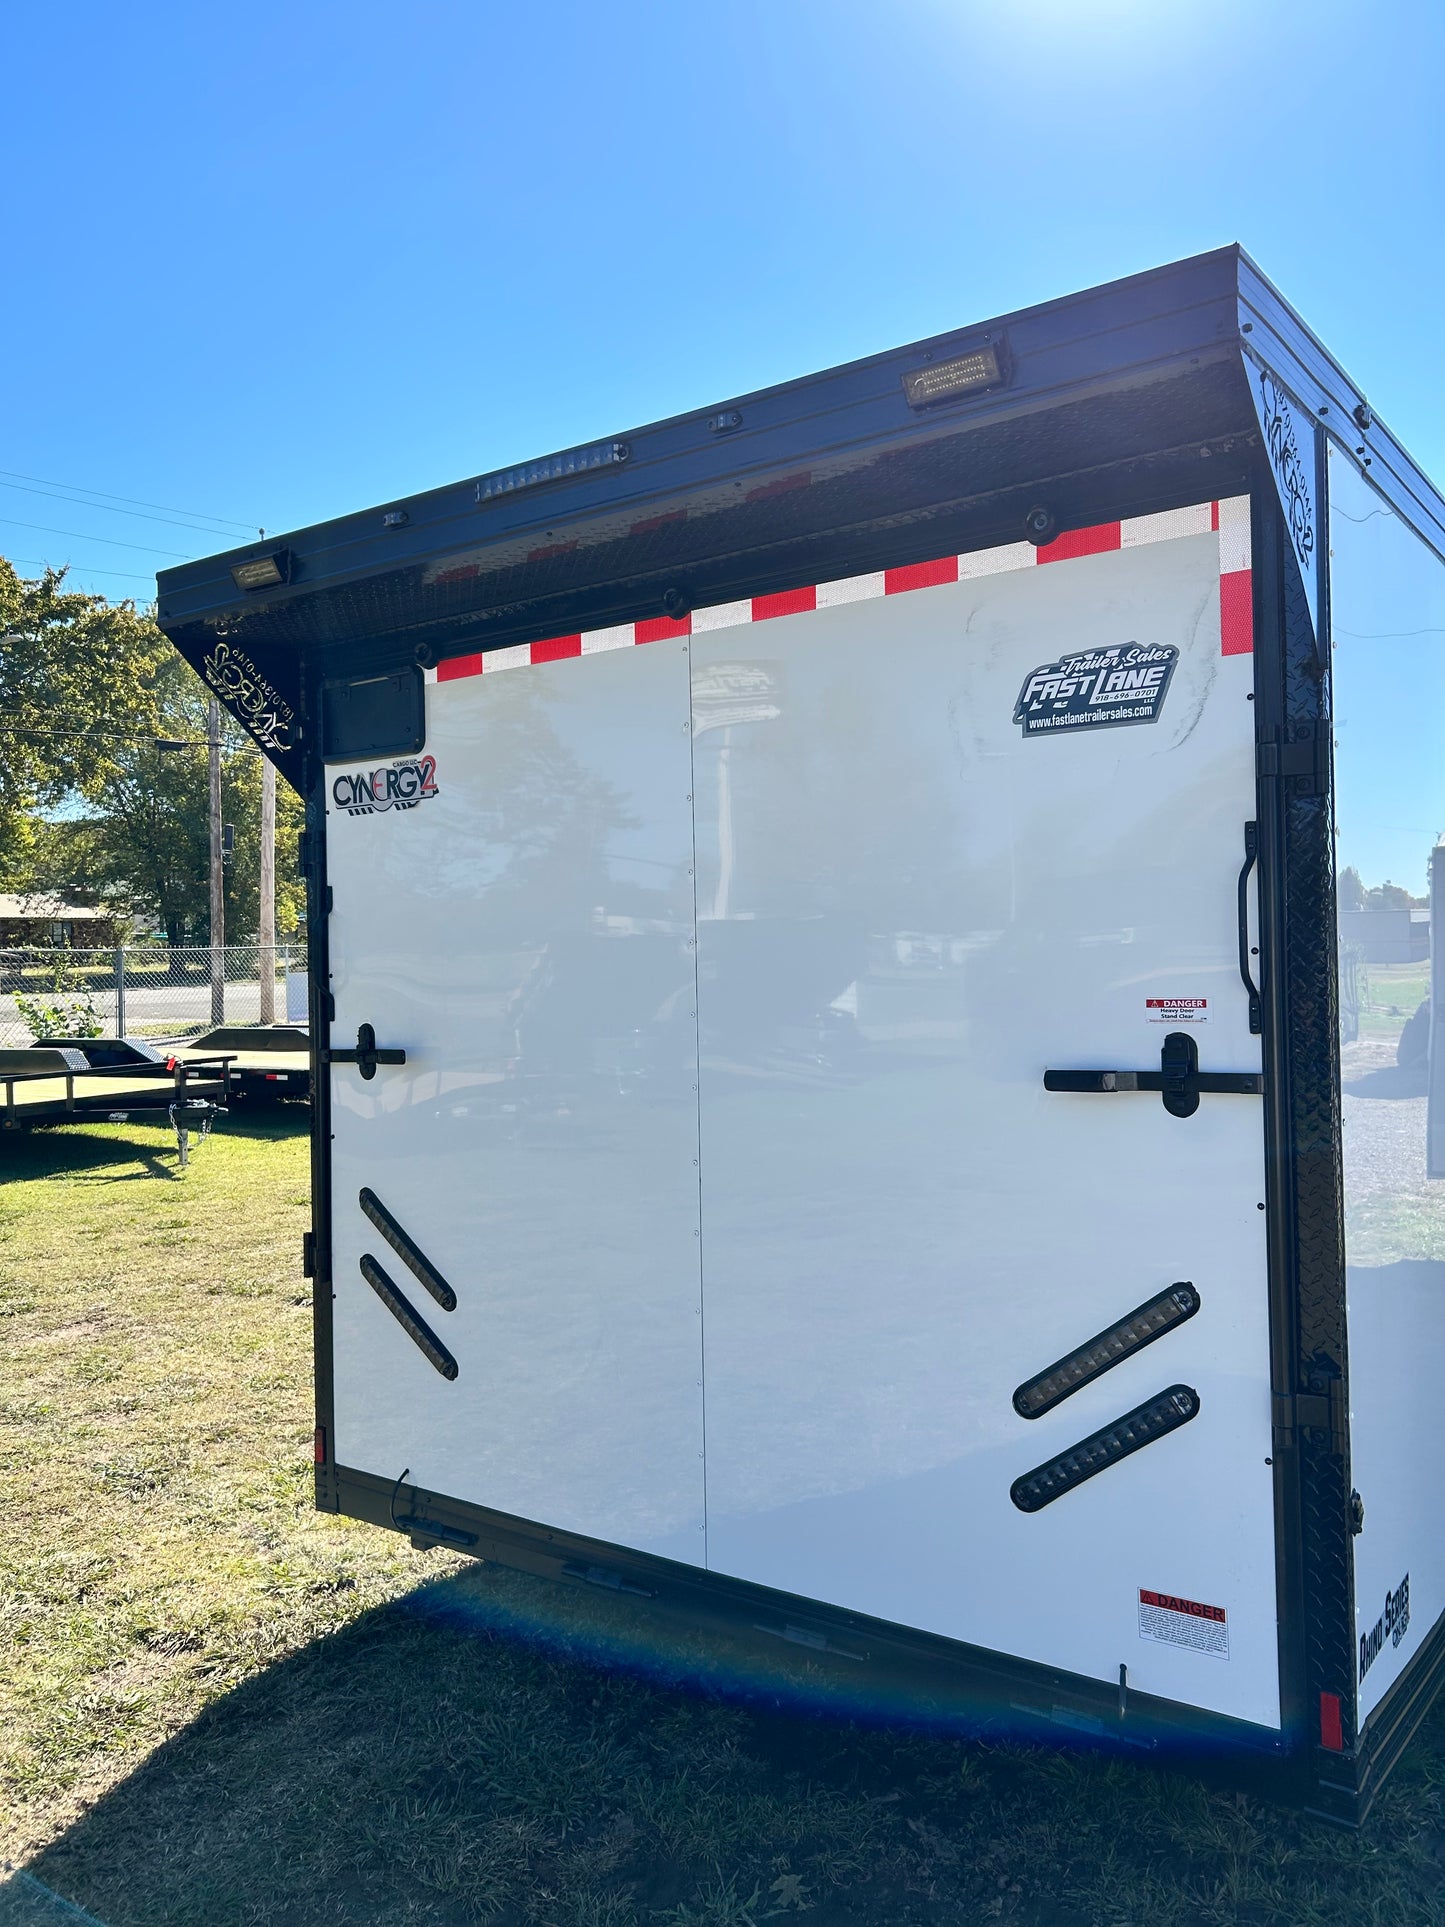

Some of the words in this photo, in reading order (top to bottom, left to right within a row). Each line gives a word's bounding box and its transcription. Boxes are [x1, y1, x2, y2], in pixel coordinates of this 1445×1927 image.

[1064, 654, 1120, 675] Trailer
[1122, 647, 1173, 667] Sales
[1094, 688, 1157, 703] 918-696-0701
[1028, 705, 1153, 729] www.fastlanetrailersales.com
[1163, 1000, 1203, 1008] DANGER
[1157, 1593, 1224, 1621] DANGER
